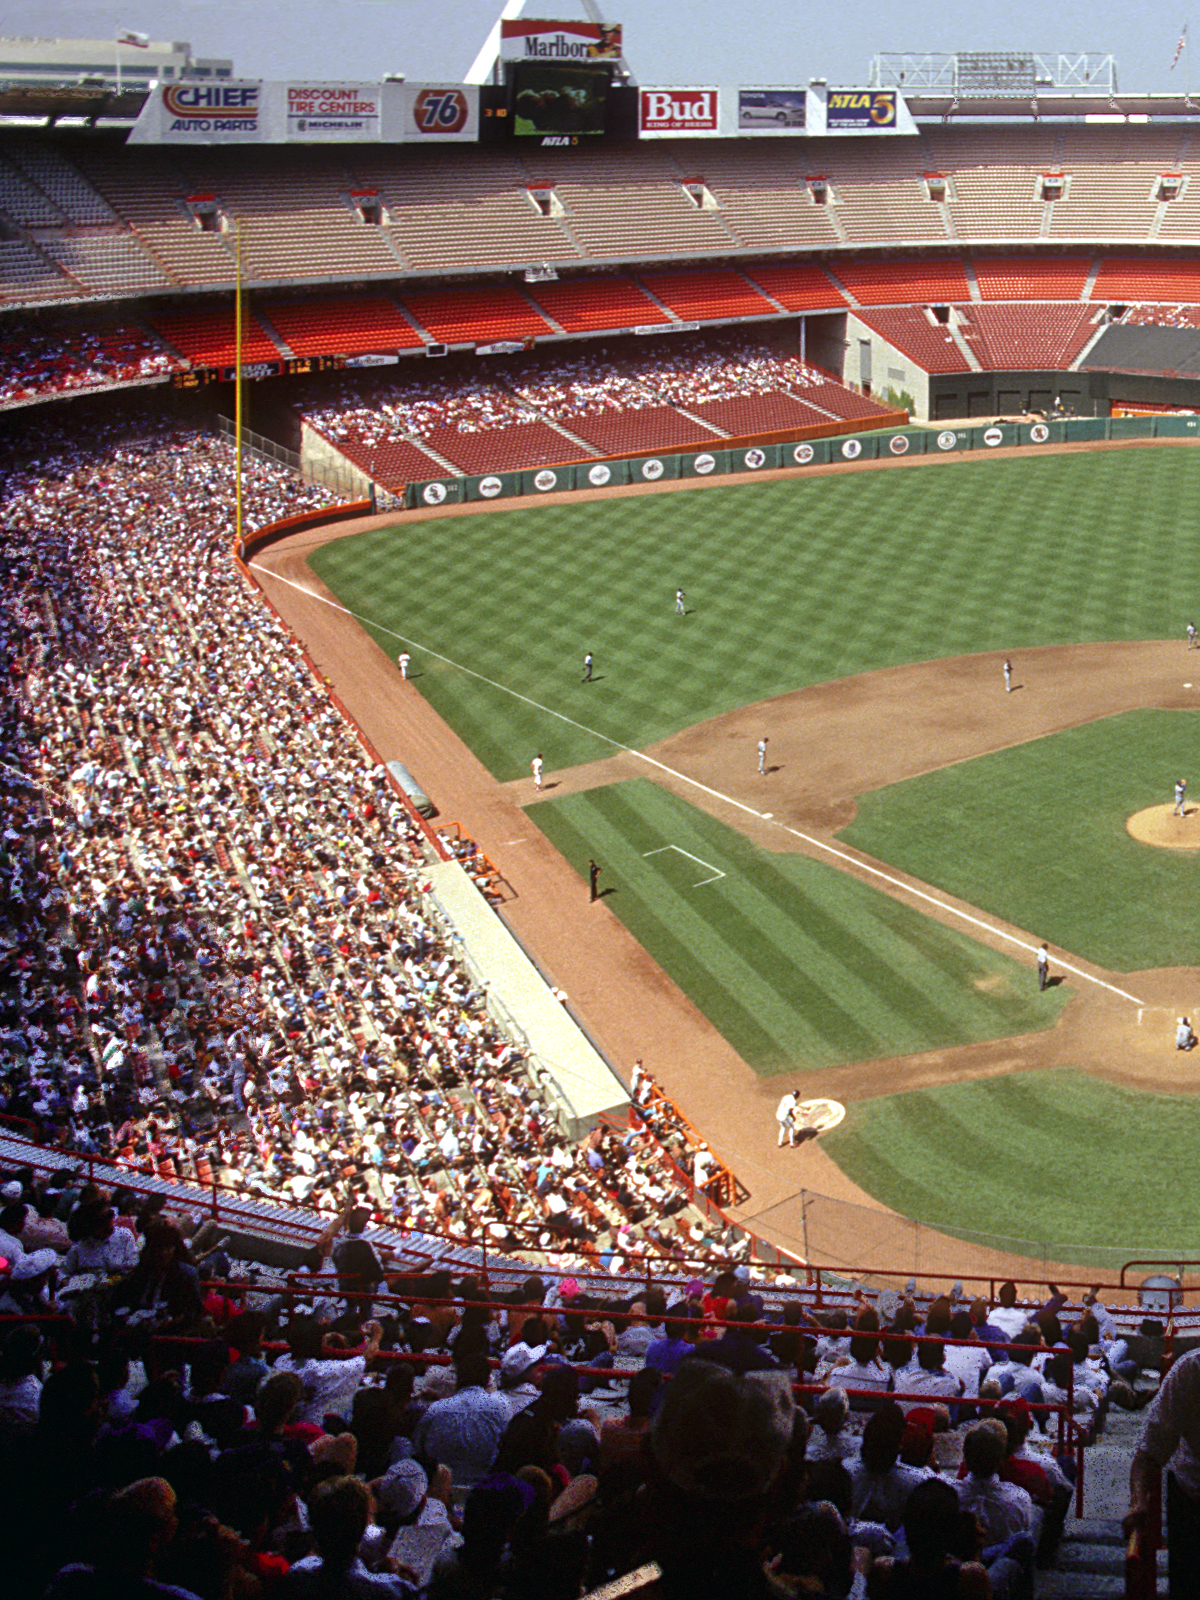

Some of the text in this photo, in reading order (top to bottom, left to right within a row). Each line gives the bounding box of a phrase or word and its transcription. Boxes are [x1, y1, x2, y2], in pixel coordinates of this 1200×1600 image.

[524, 34, 592, 57] Marlbor
[176, 87, 258, 107] CHIEF
[287, 88, 359, 100] DISCOUNT
[288, 101, 376, 113] TIRE CENTERS
[422, 92, 460, 127] 76
[645, 92, 713, 120] Bud
[828, 94, 895, 124] KTLA 5
[169, 119, 258, 131] AUTO PARTS
[541, 136, 570, 146] KTLA
